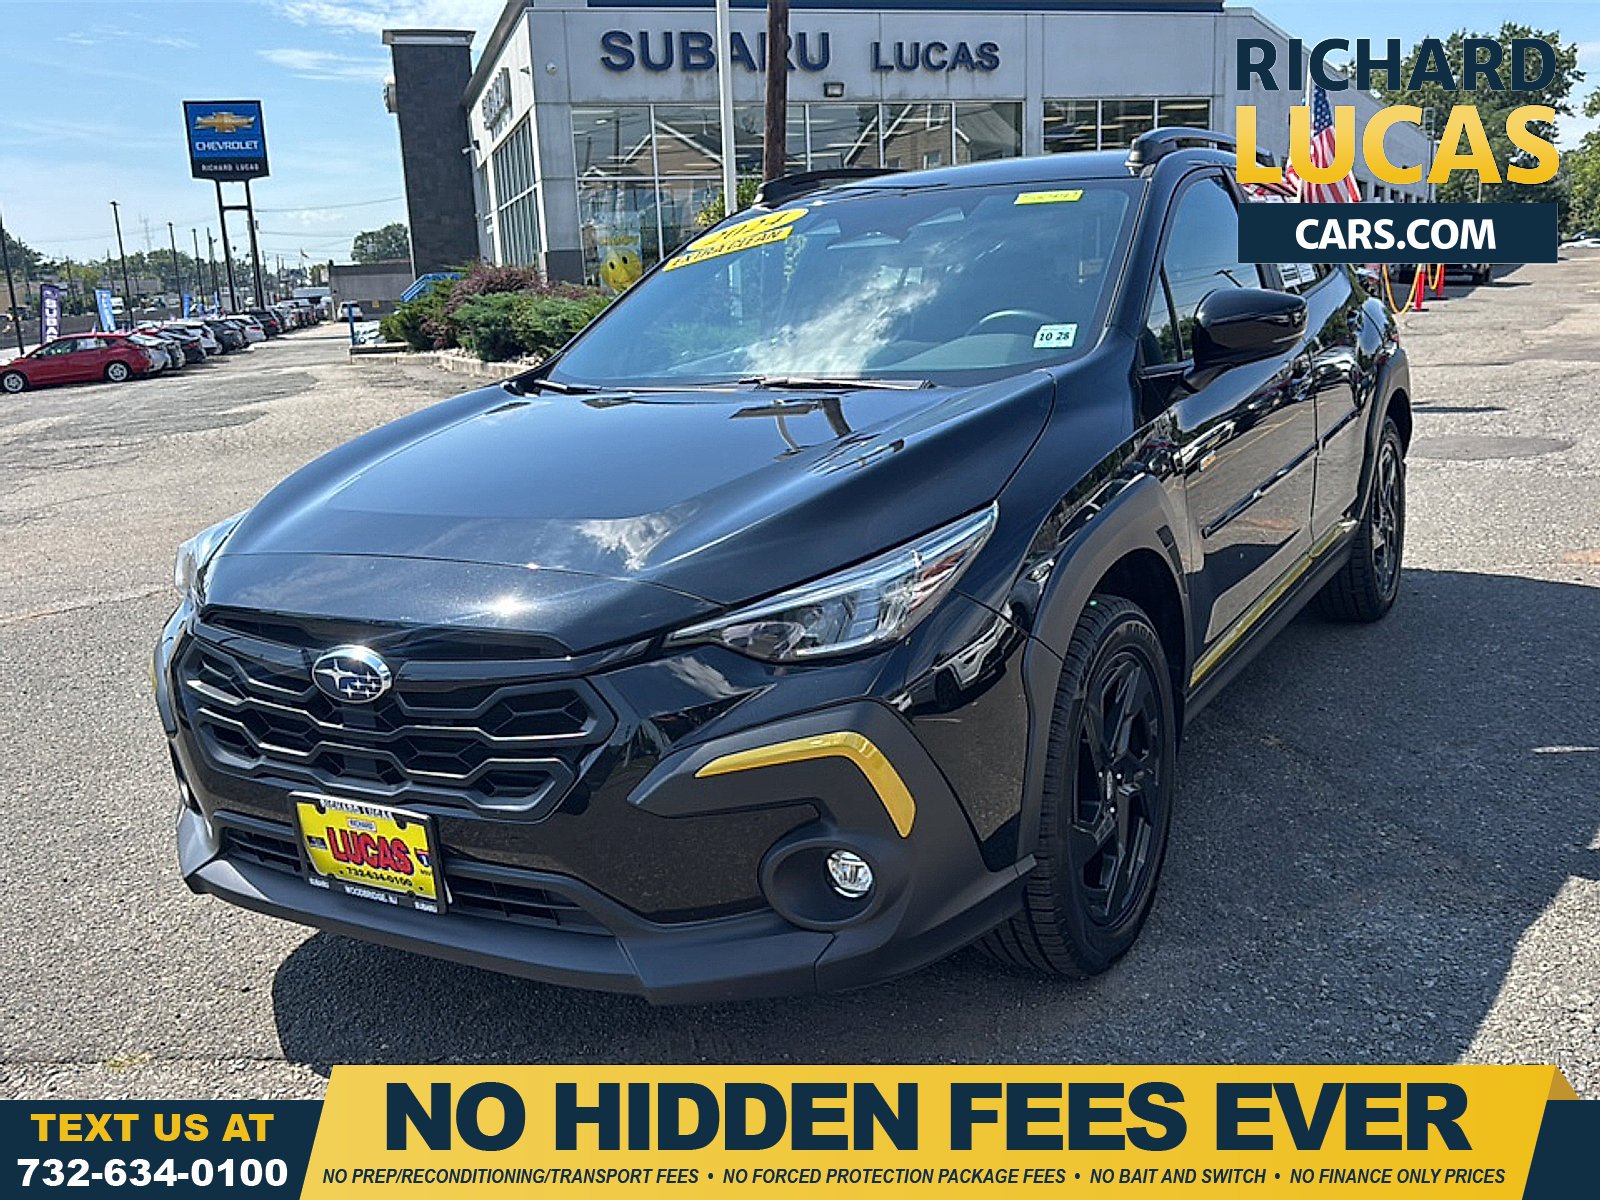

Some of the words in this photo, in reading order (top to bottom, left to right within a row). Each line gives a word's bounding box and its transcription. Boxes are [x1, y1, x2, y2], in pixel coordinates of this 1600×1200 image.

[871, 40, 1001, 72] LUCAS
[195, 141, 258, 151] CHEVROLET
[235, 163, 260, 171] LUCAS
[1040, 332, 1053, 341] 10
[327, 827, 414, 875] LUCAS
